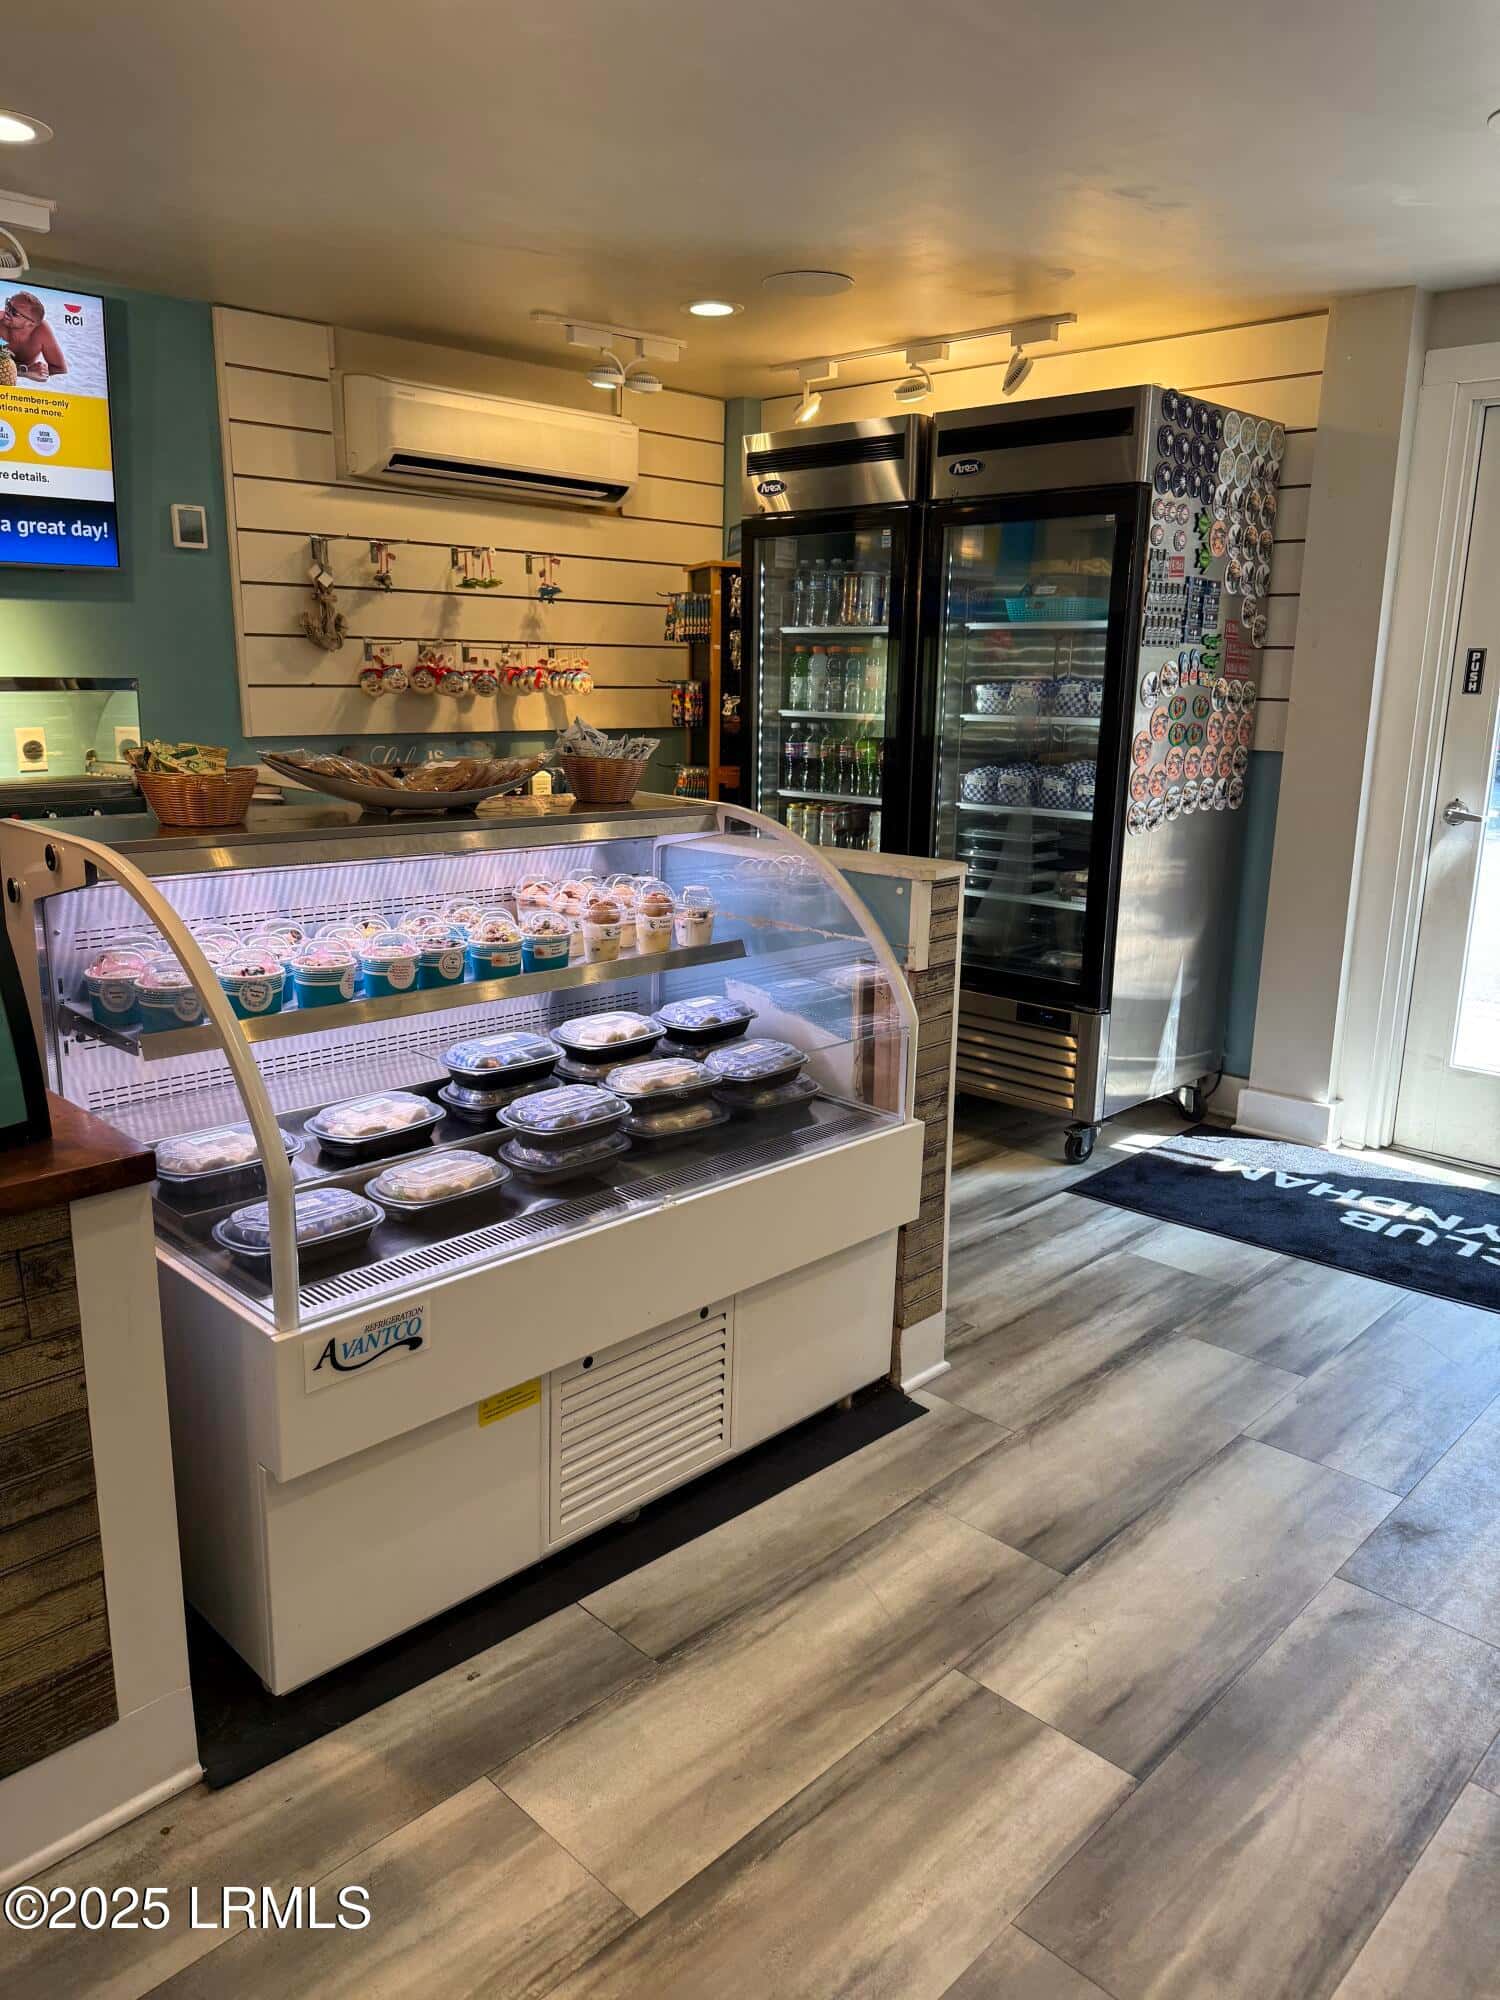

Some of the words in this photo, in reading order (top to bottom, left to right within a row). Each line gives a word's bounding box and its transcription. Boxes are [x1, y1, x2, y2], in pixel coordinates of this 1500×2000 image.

[64, 314, 83, 326] RCI
[0, 392, 9, 400] of
[10, 395, 69, 408] members-only
[41, 409, 64, 417] more.
[11, 470, 50, 483] details.
[0, 519, 12, 532] a
[17, 520, 67, 538] great
[71, 519, 109, 542] day!
[1467, 652, 1481, 692] PUSH
[364, 1305, 424, 1333] REFRIGERATION
[312, 1316, 423, 1371] AVANTCO
